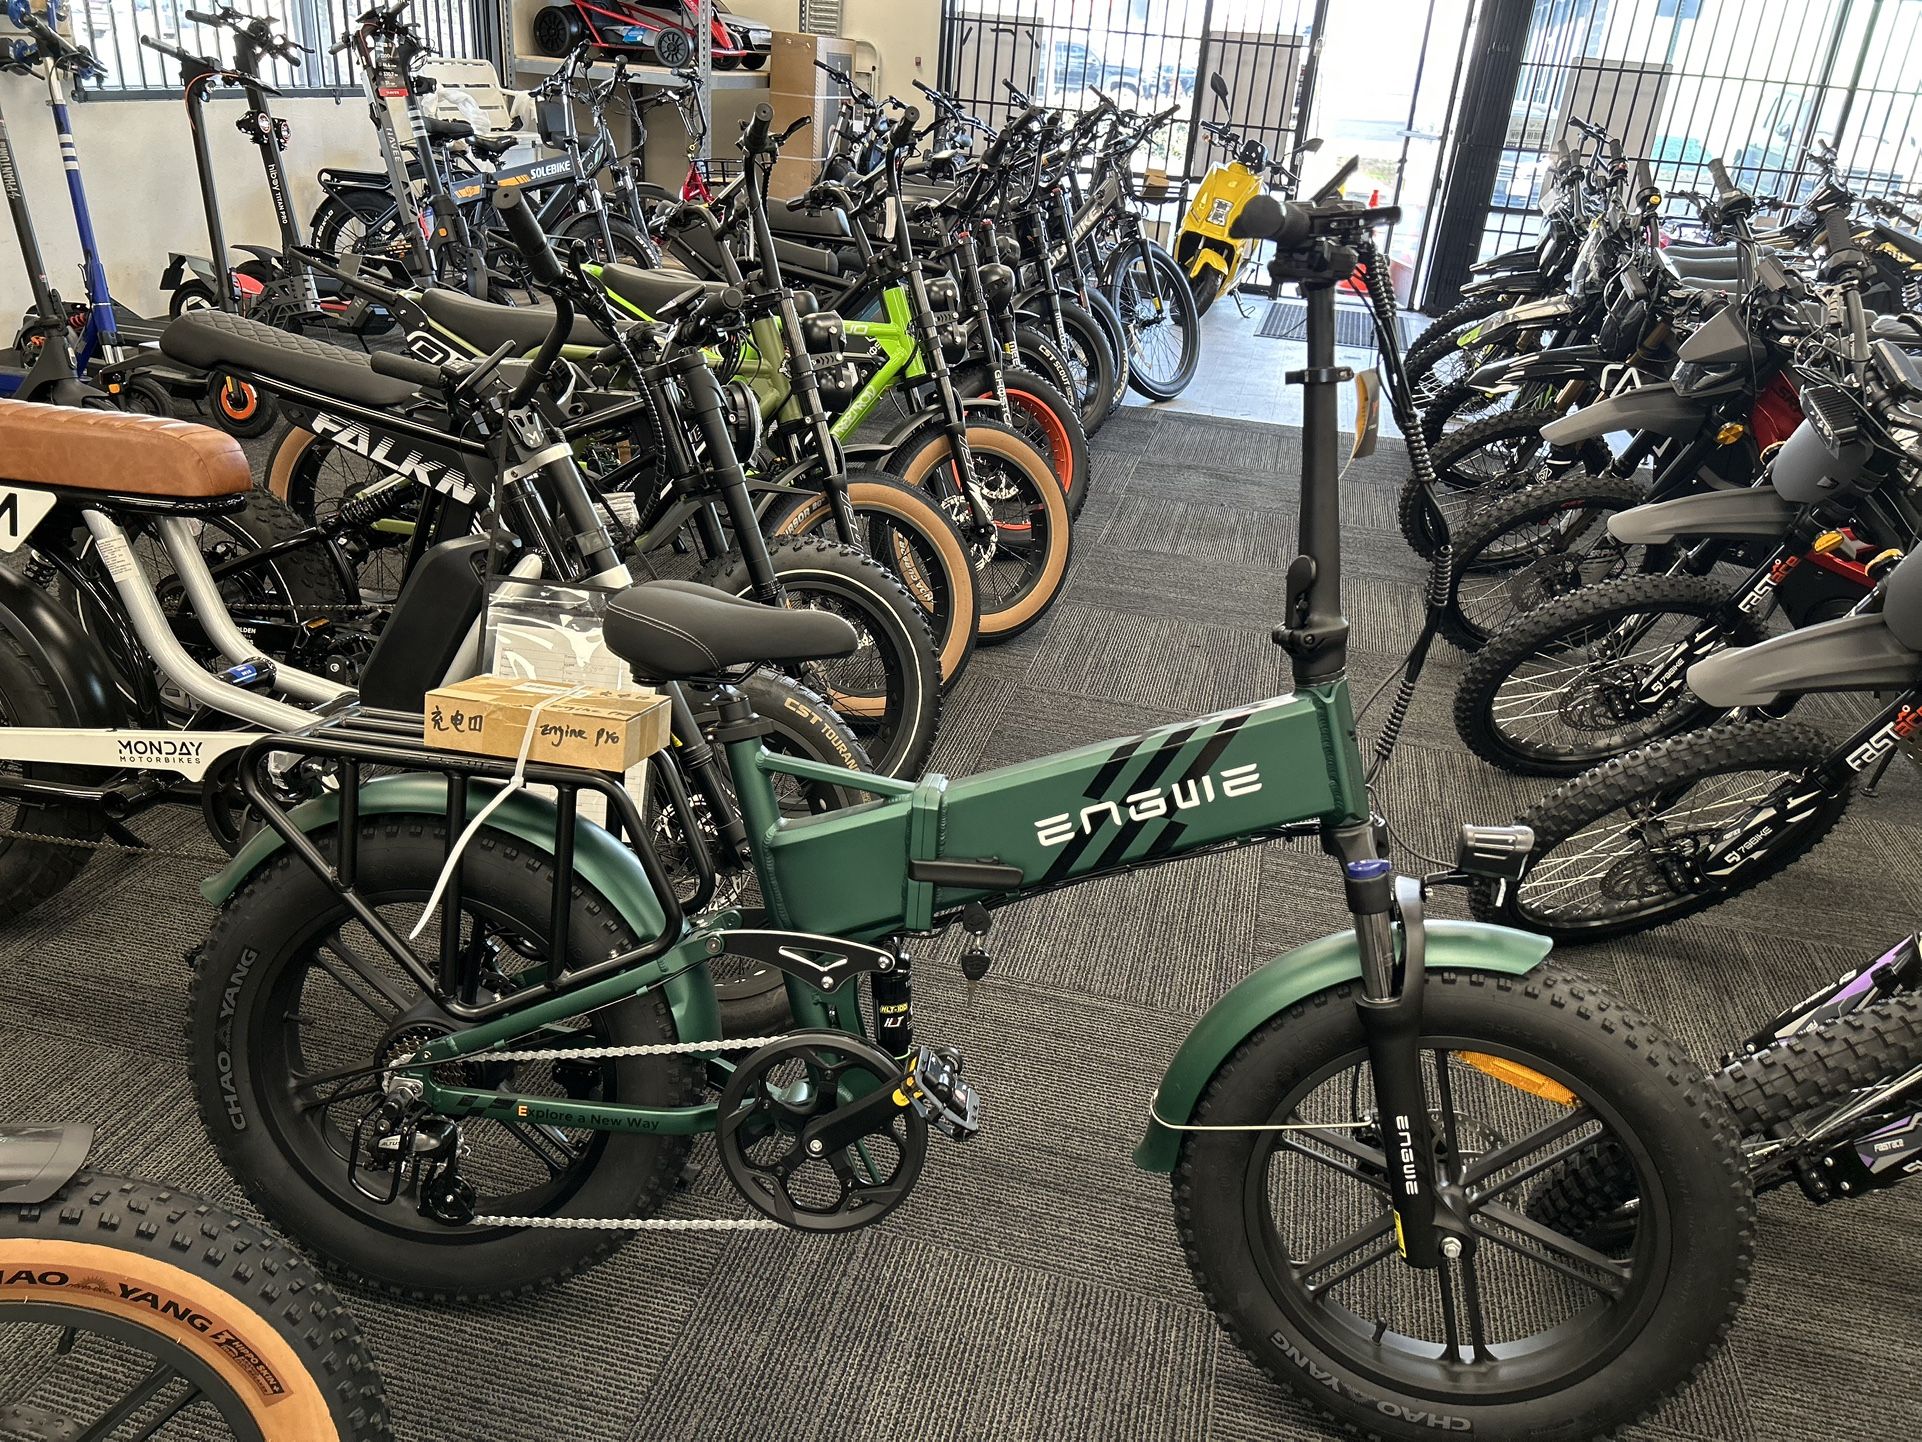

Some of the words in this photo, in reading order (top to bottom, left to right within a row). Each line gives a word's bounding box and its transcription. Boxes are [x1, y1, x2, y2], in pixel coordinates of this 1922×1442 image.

[530, 160, 571, 180] SOLEBIKE
[275, 191, 286, 211] TITAN
[280, 210, 288, 224] PRO
[1038, 344, 1057, 362] CST
[1053, 361, 1070, 386] SCOUT
[994, 369, 1013, 427] GHOSTCA
[117, 740, 203, 756] MONDAY
[784, 697, 823, 725] CST
[821, 723, 861, 772] TOURAN
[119, 756, 201, 765] MOTORBIKES
[1034, 763, 1263, 847] ENGWE
[220, 948, 259, 1019] YANG
[217, 1051, 246, 1130] CHAO
[518, 1105, 574, 1123] Explore
[578, 1113, 586, 1124] a
[590, 1114, 623, 1126] New
[626, 1117, 660, 1131] Way
[1395, 1115, 1419, 1195] ENGWE
[0, 1270, 70, 1287] AO
[118, 1282, 213, 1333] YANG
[232, 1341, 259, 1364] HIPPO
[1270, 1331, 1341, 1393] YANG
[1377, 1401, 1473, 1432] CHAO
